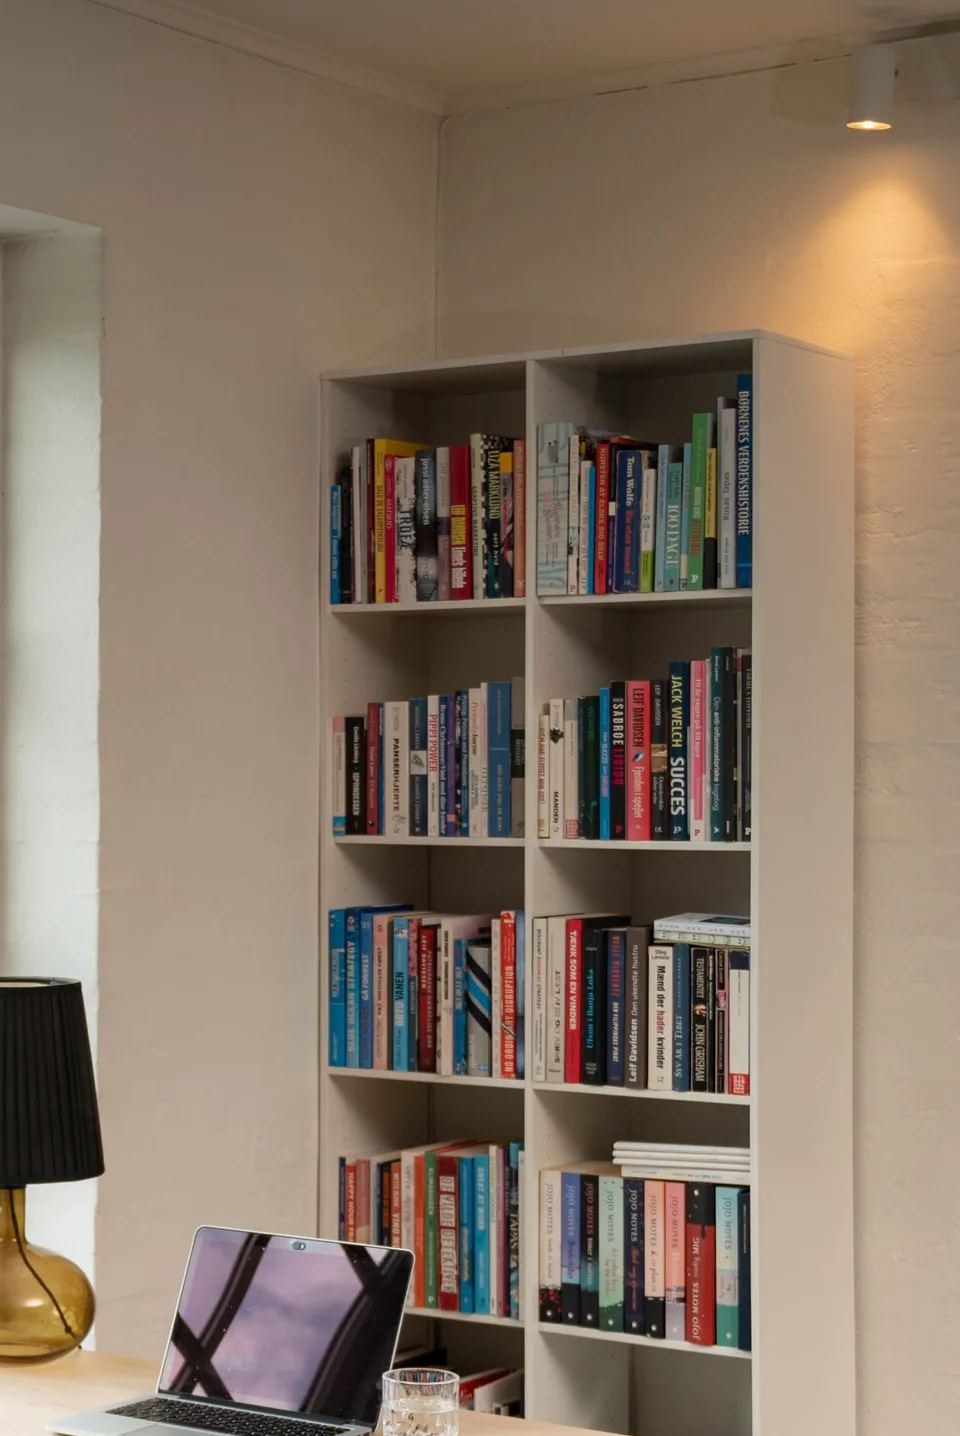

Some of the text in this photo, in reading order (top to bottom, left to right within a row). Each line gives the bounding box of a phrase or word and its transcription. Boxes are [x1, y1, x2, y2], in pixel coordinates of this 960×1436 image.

[738, 391, 749, 536] BØRNENES VERDENSHISTORIE
[421, 458, 430, 525] jussi adler-olsen
[488, 450, 500, 519] LIZA MARKLUND
[626, 456, 634, 506] Tom Wolfe
[451, 504, 466, 516] LEIF
[598, 448, 606, 560] KUNSTEN AT ELSKE SIG SELV
[400, 508, 412, 550] TROFÆ
[666, 530, 680, 570] DAGE
[694, 679, 702, 687] 10
[613, 703, 624, 746] SABROE
[632, 688, 644, 747] LEIF DAVIDSEN
[428, 714, 438, 772] PIPPI POWER
[670, 674, 684, 816] JACK WELCH SUCCES
[694, 732, 702, 740] 10
[632, 766, 644, 792] Fjenden
[352, 772, 360, 816] ISPRINSESSEN
[632, 796, 644, 818] spejlet
[394, 971, 404, 1000] VANEN
[504, 966, 514, 1013] DISRUPTION
[570, 982, 577, 994] EN
[696, 958, 704, 998] TESTAMENTET
[347, 941, 355, 1052] BLUE OCEAN STRATEGY
[361, 990, 368, 1000] GÅ
[554, 1020, 561, 1034] OG
[656, 965, 666, 1069] Mænd der hader kvinder
[628, 1019, 638, 1062] Davidsen
[694, 1024, 705, 1082] JOHN GRISHAM
[504, 1062, 514, 1072] NO
[628, 1063, 638, 1082] Leif
[477, 1194, 484, 1205] AT
[546, 1184, 554, 1204] JOJO
[566, 1185, 574, 1205] JOJO
[585, 1182, 593, 1203] JOJO
[606, 1190, 614, 1210] JOJO
[629, 1188, 638, 1210] JOJO
[647, 1194, 656, 1214] JOJO
[670, 1195, 678, 1216] JOJO
[392, 1213, 400, 1234] VIND
[440, 1176, 455, 1292] DE VILDE DETEKTIVER
[510, 1212, 518, 1250] TAPAS
[722, 1197, 732, 1250] JOJO MOYES
[692, 1238, 700, 1255] MIG
[692, 1316, 701, 1340] JOJO
